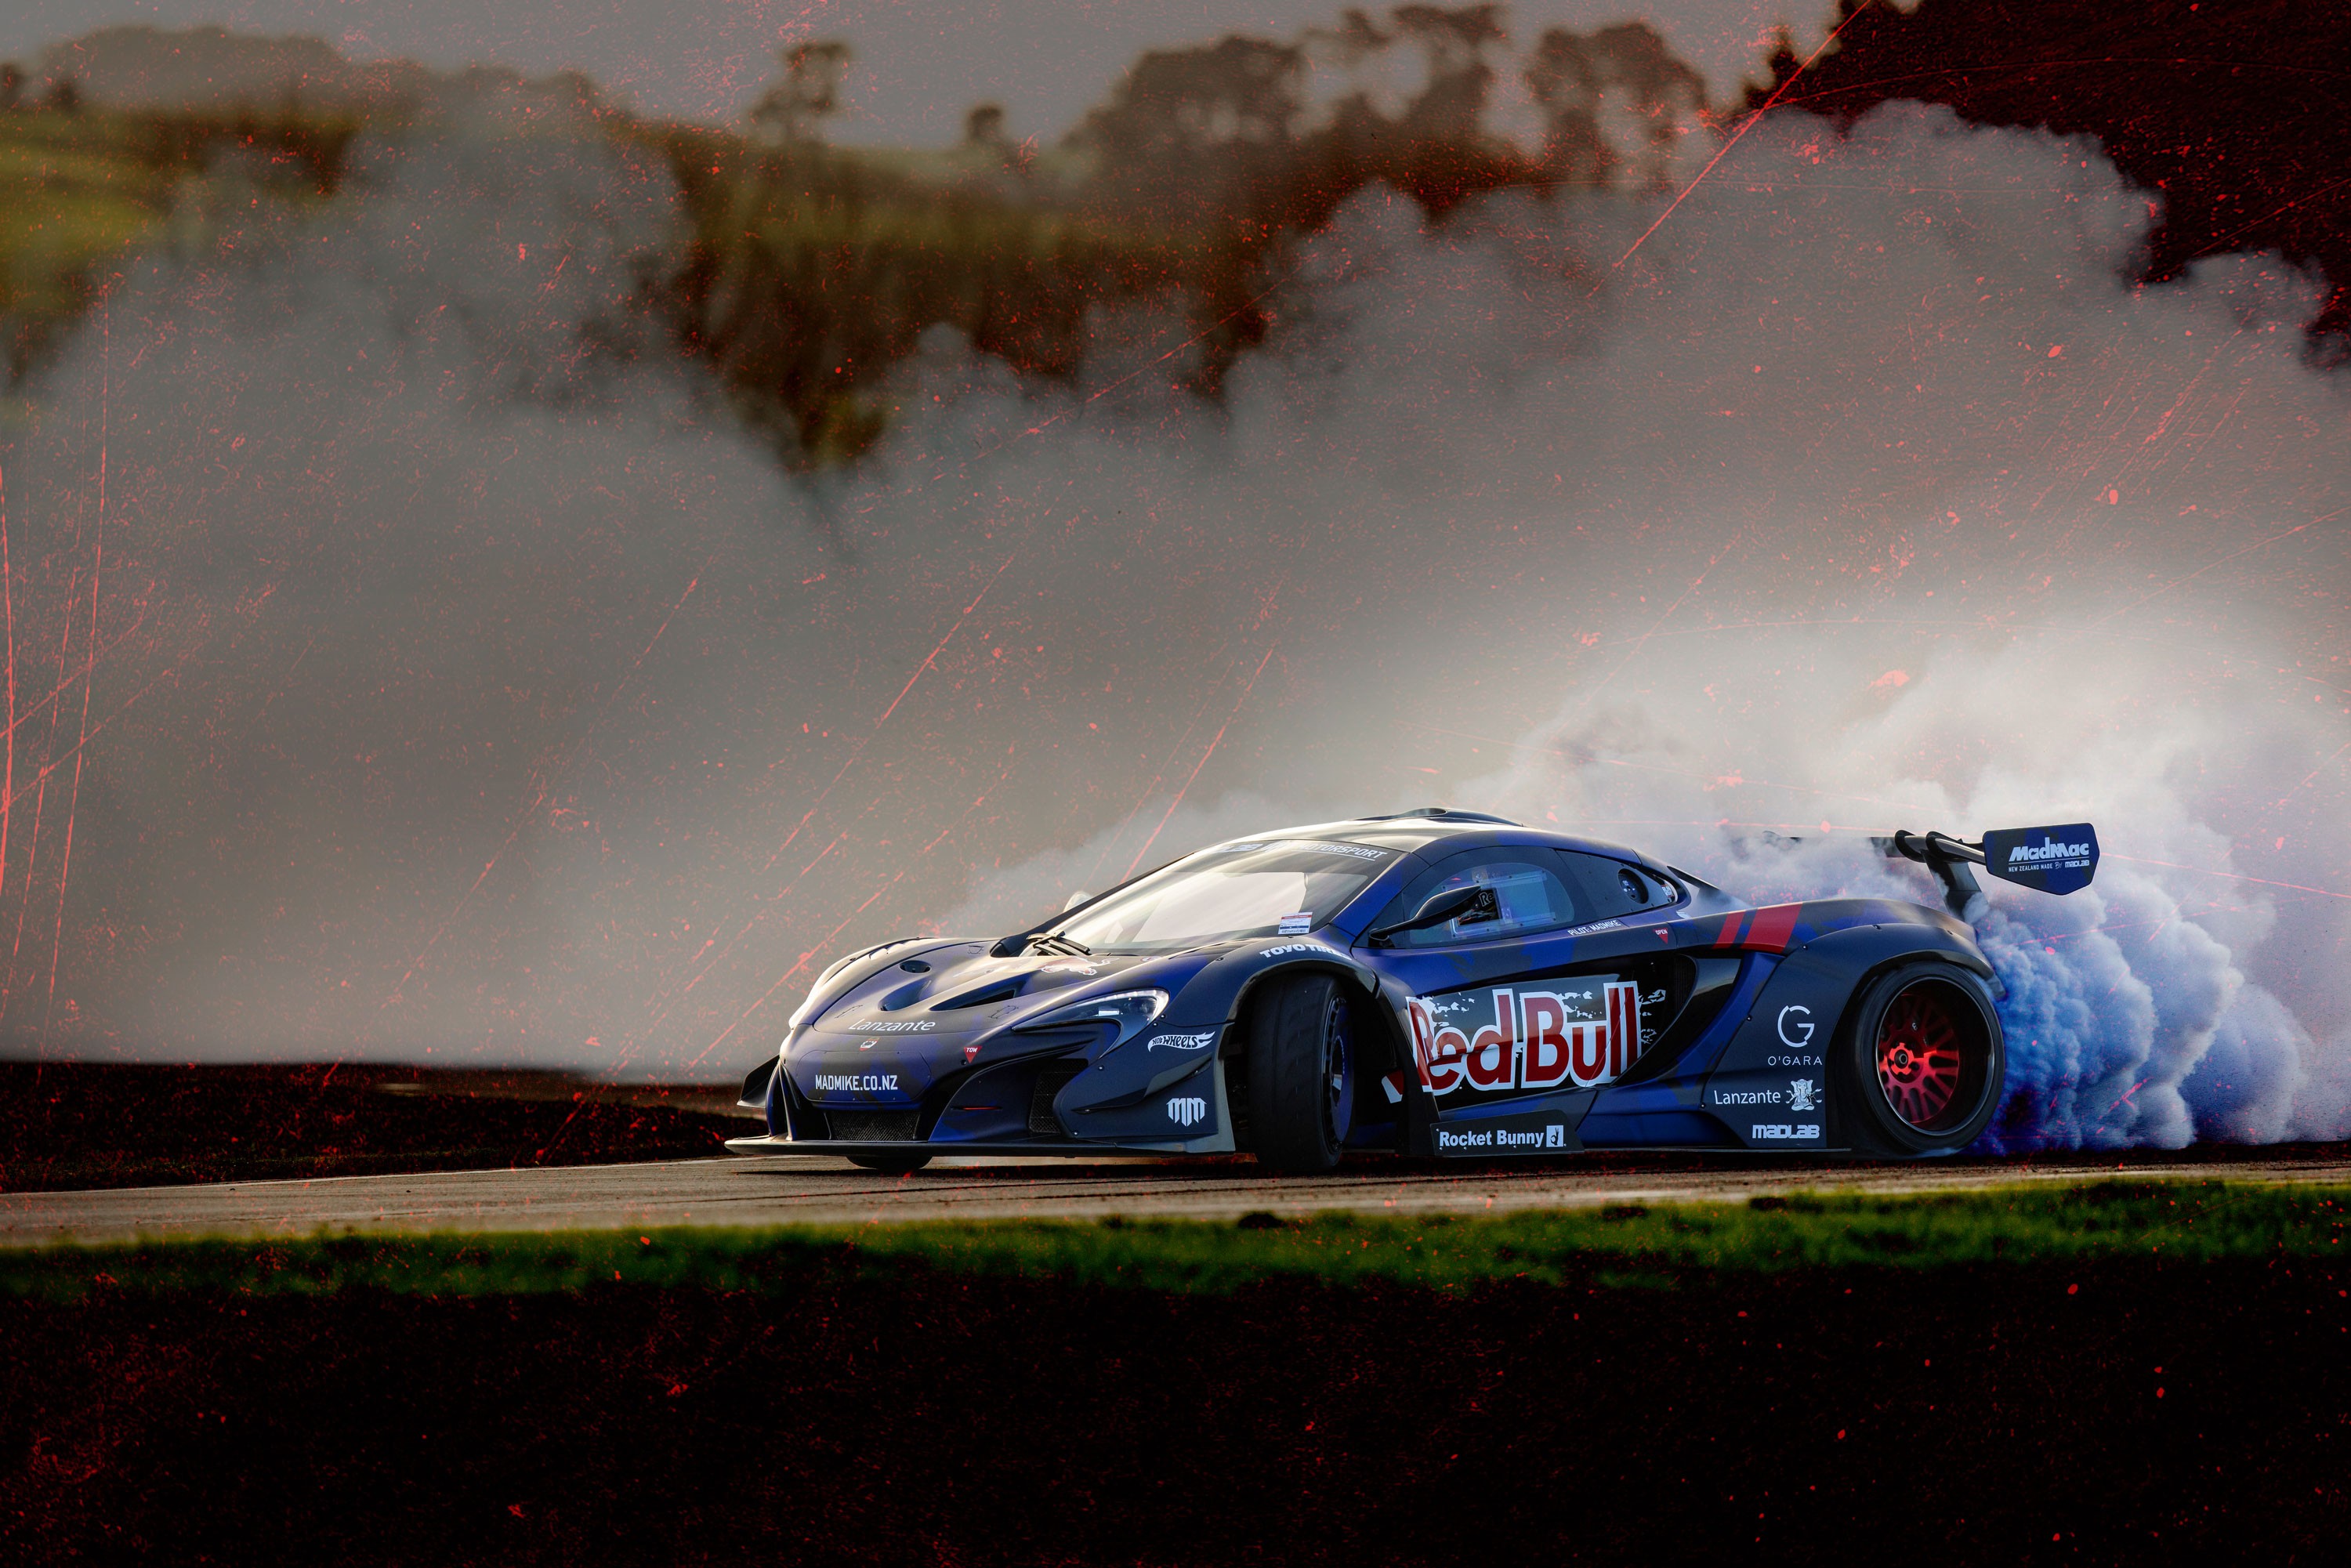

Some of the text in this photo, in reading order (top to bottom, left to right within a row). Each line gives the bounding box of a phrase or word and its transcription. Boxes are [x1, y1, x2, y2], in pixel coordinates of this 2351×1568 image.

[2009, 837, 2089, 862] MadMac
[1567, 920, 1621, 936] PILOT: MADMIKE
[1259, 943, 1353, 961] TOYO TIR
[848, 1018, 936, 1032] Lanzante
[1406, 980, 1643, 1096] Red Bull
[1767, 1056, 1823, 1066] O'GARA
[815, 1074, 898, 1091] MADMIKE.CO.NZ
[1714, 1089, 1781, 1105] Lanzante
[1439, 1129, 1545, 1148] Rocket Bunny
